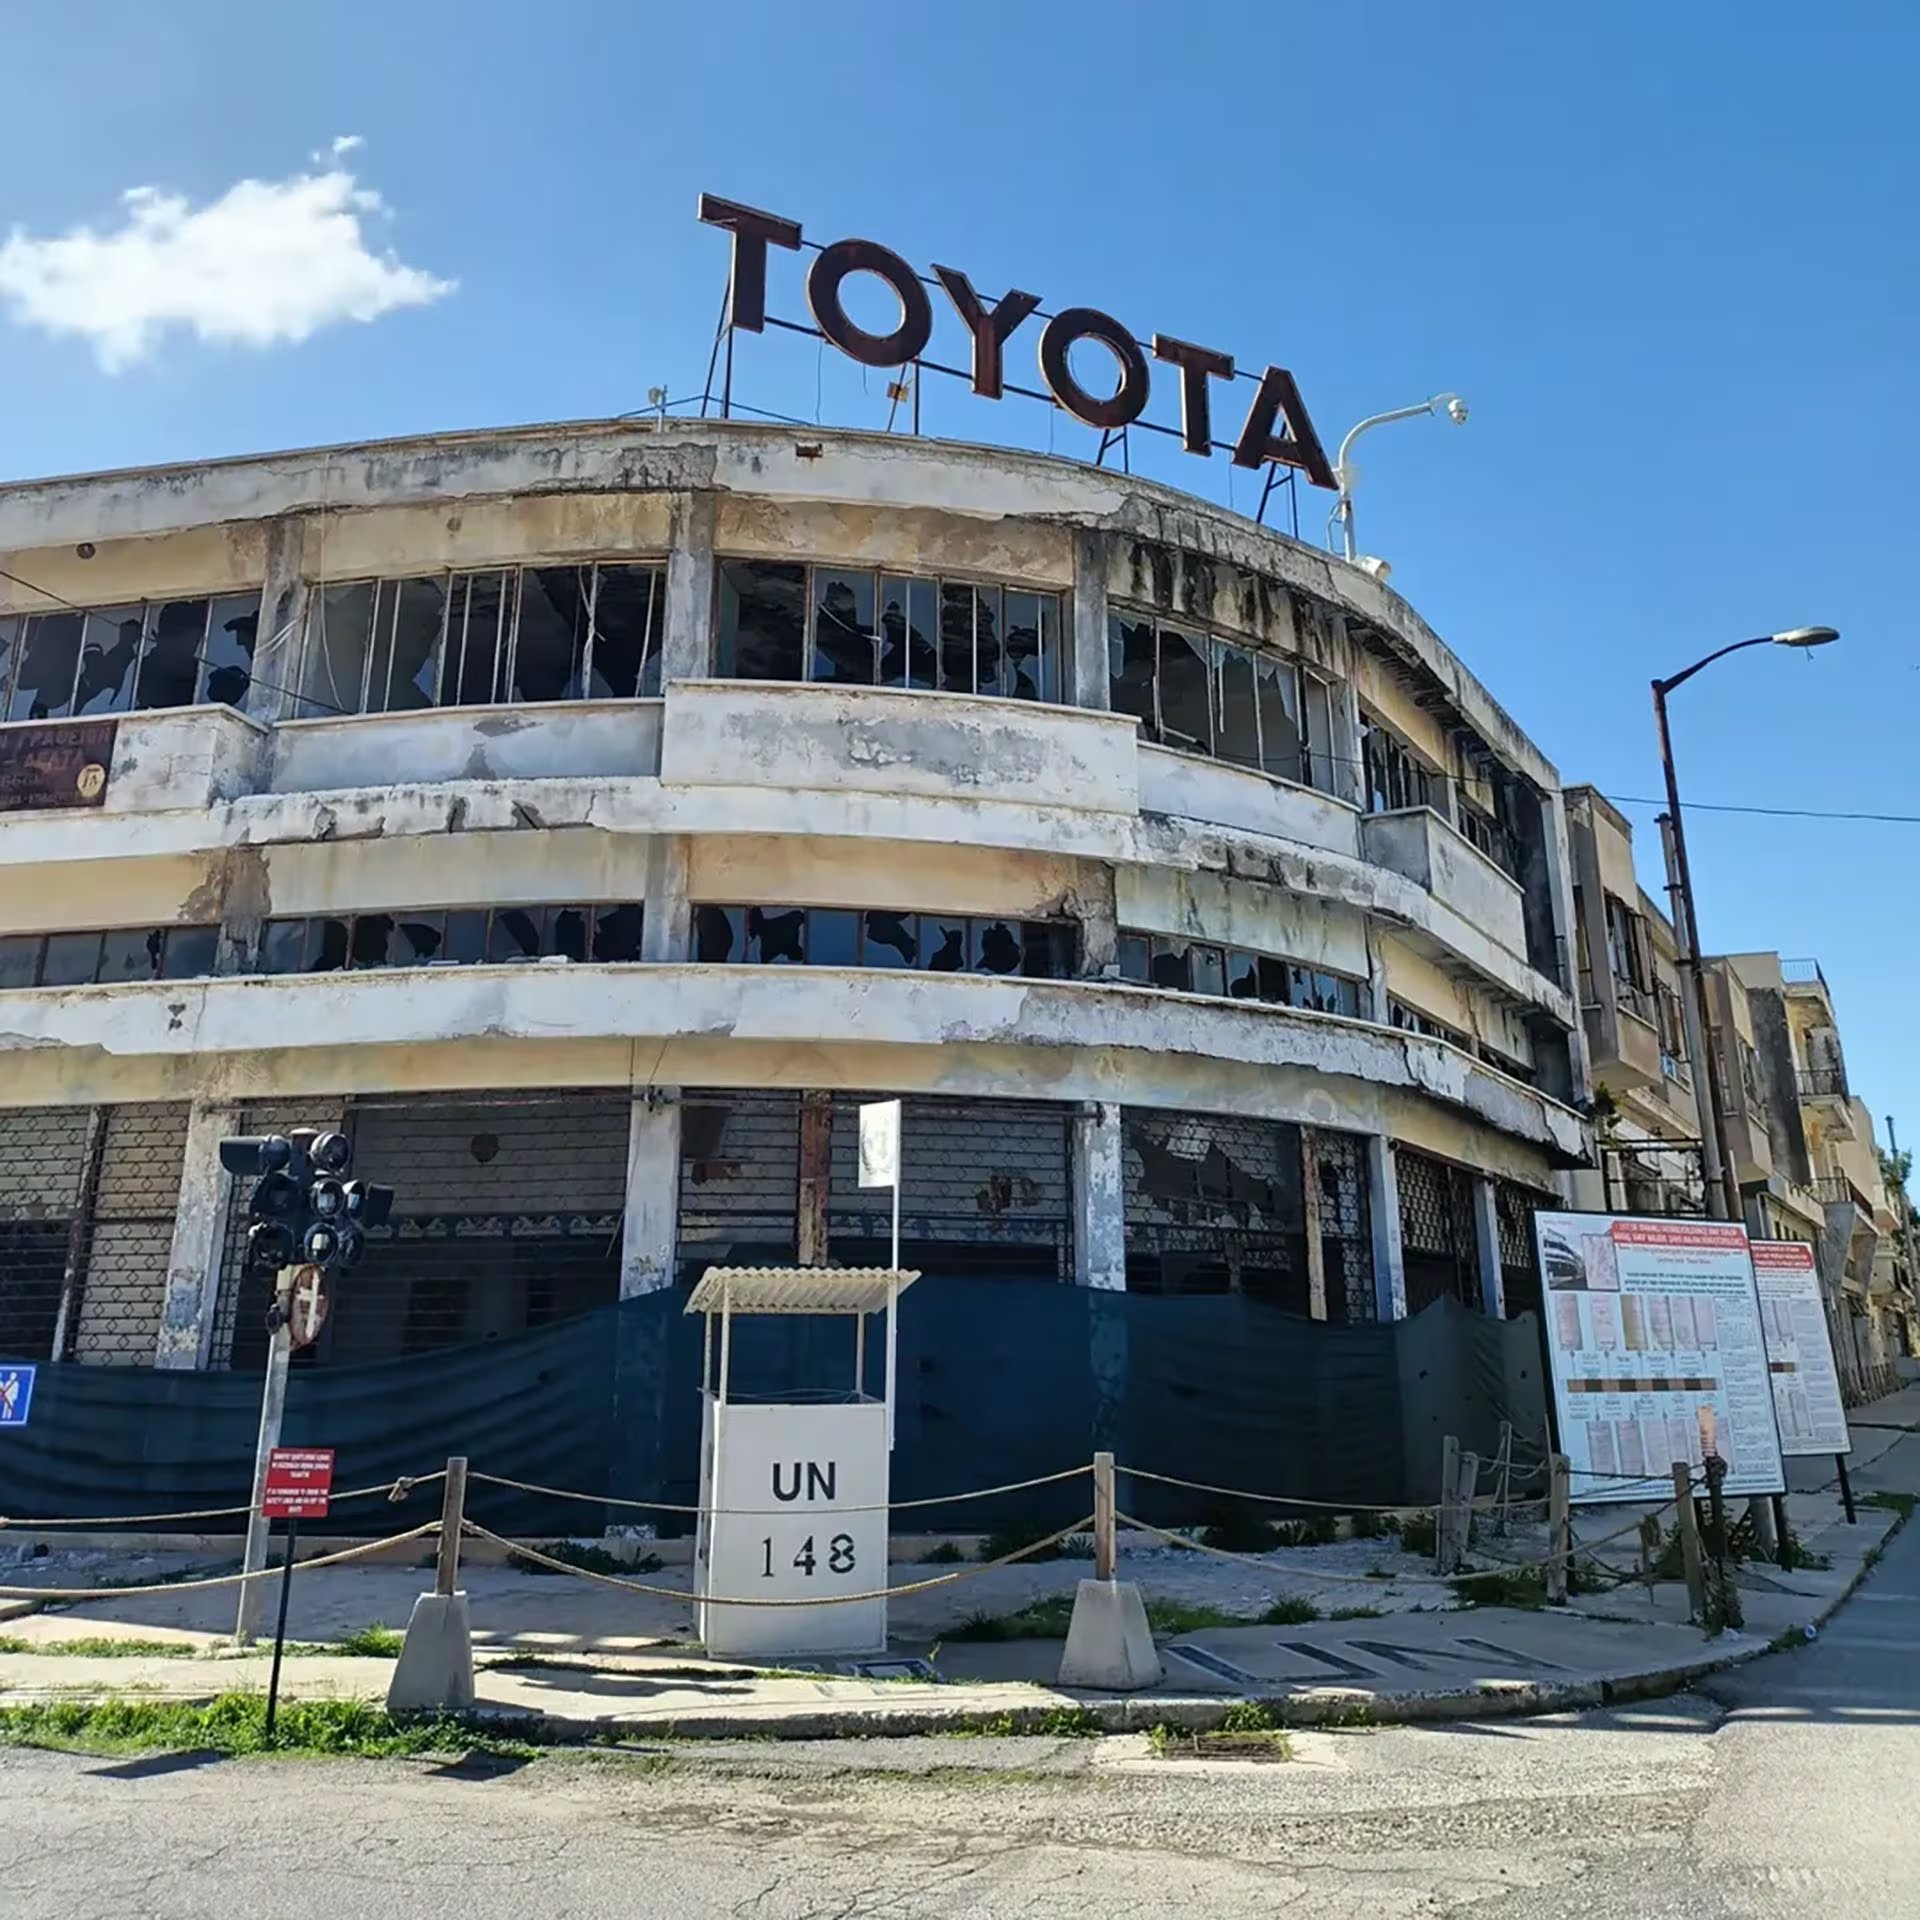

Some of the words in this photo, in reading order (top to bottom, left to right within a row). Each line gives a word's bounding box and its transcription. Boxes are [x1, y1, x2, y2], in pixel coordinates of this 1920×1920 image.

[698, 193, 1338, 490] TOYOTA
[772, 1461, 836, 1501] UN
[761, 1533, 857, 1577] 148
